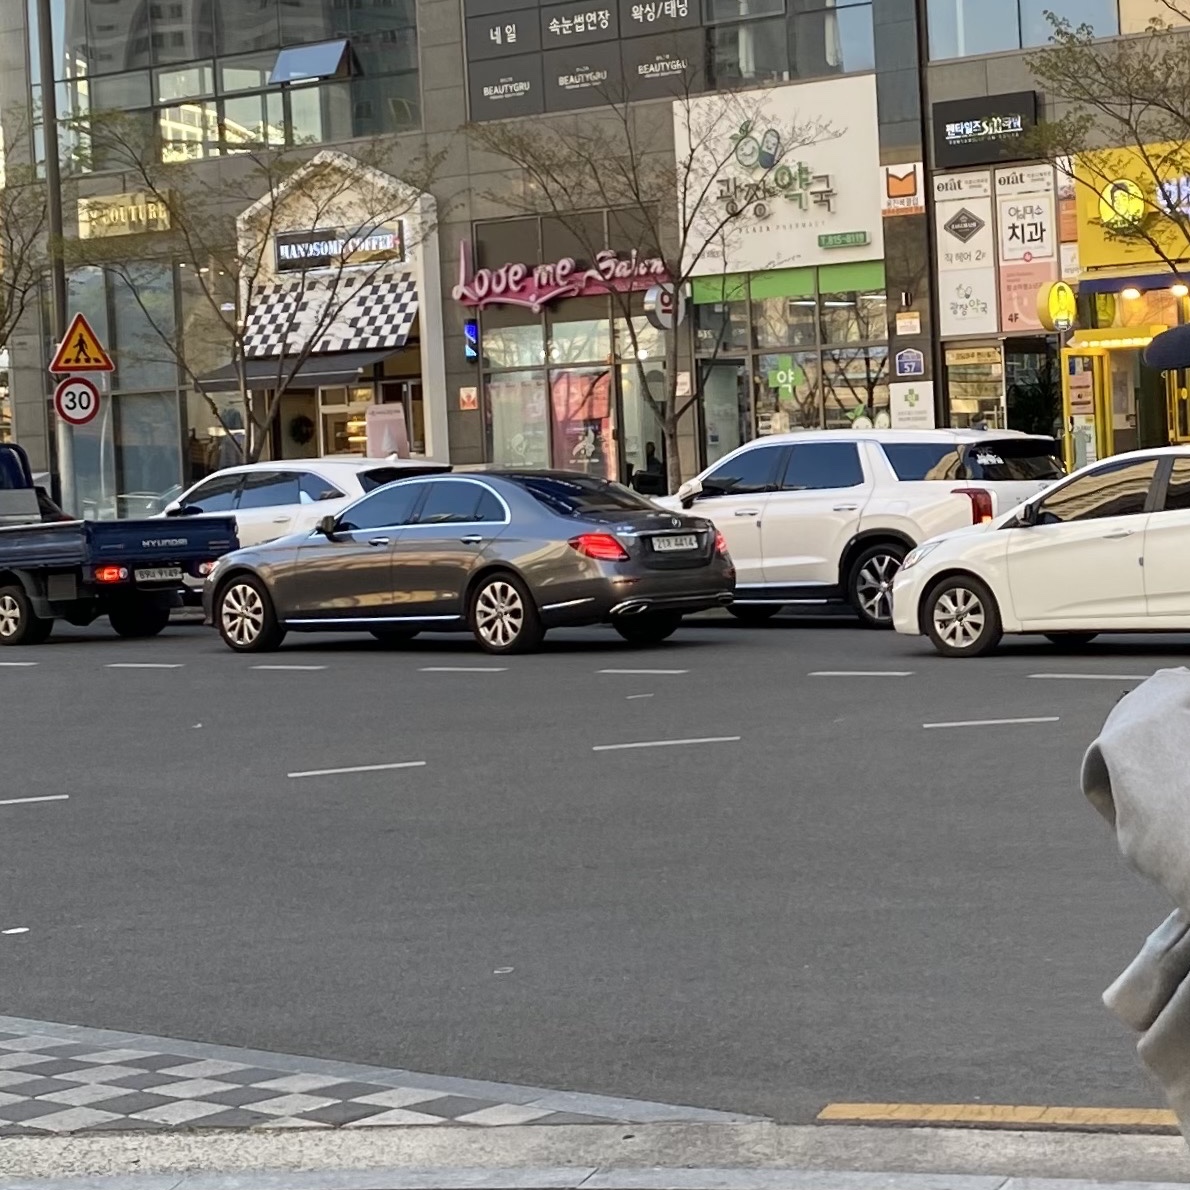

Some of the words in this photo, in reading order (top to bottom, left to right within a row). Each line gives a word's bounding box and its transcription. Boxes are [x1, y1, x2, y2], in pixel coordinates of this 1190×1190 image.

[549, 10, 610, 35] 속눈썹연장
[637, 59, 688, 74] BEAUTYGRU
[558, 71, 607, 86] BEAUTYGRU
[483, 81, 530, 96] BEAUTYGRU
[1008, 221, 1046, 243] 치과
[452, 239, 528, 300] Love
[533, 257, 576, 288] me
[583, 249, 666, 286] Salon
[1008, 313, 1020, 323] 4F
[904, 362, 916, 373] 57
[777, 368, 795, 393] 약
[65, 391, 91, 410] 30
[142, 538, 188, 547] HYUNDAI
